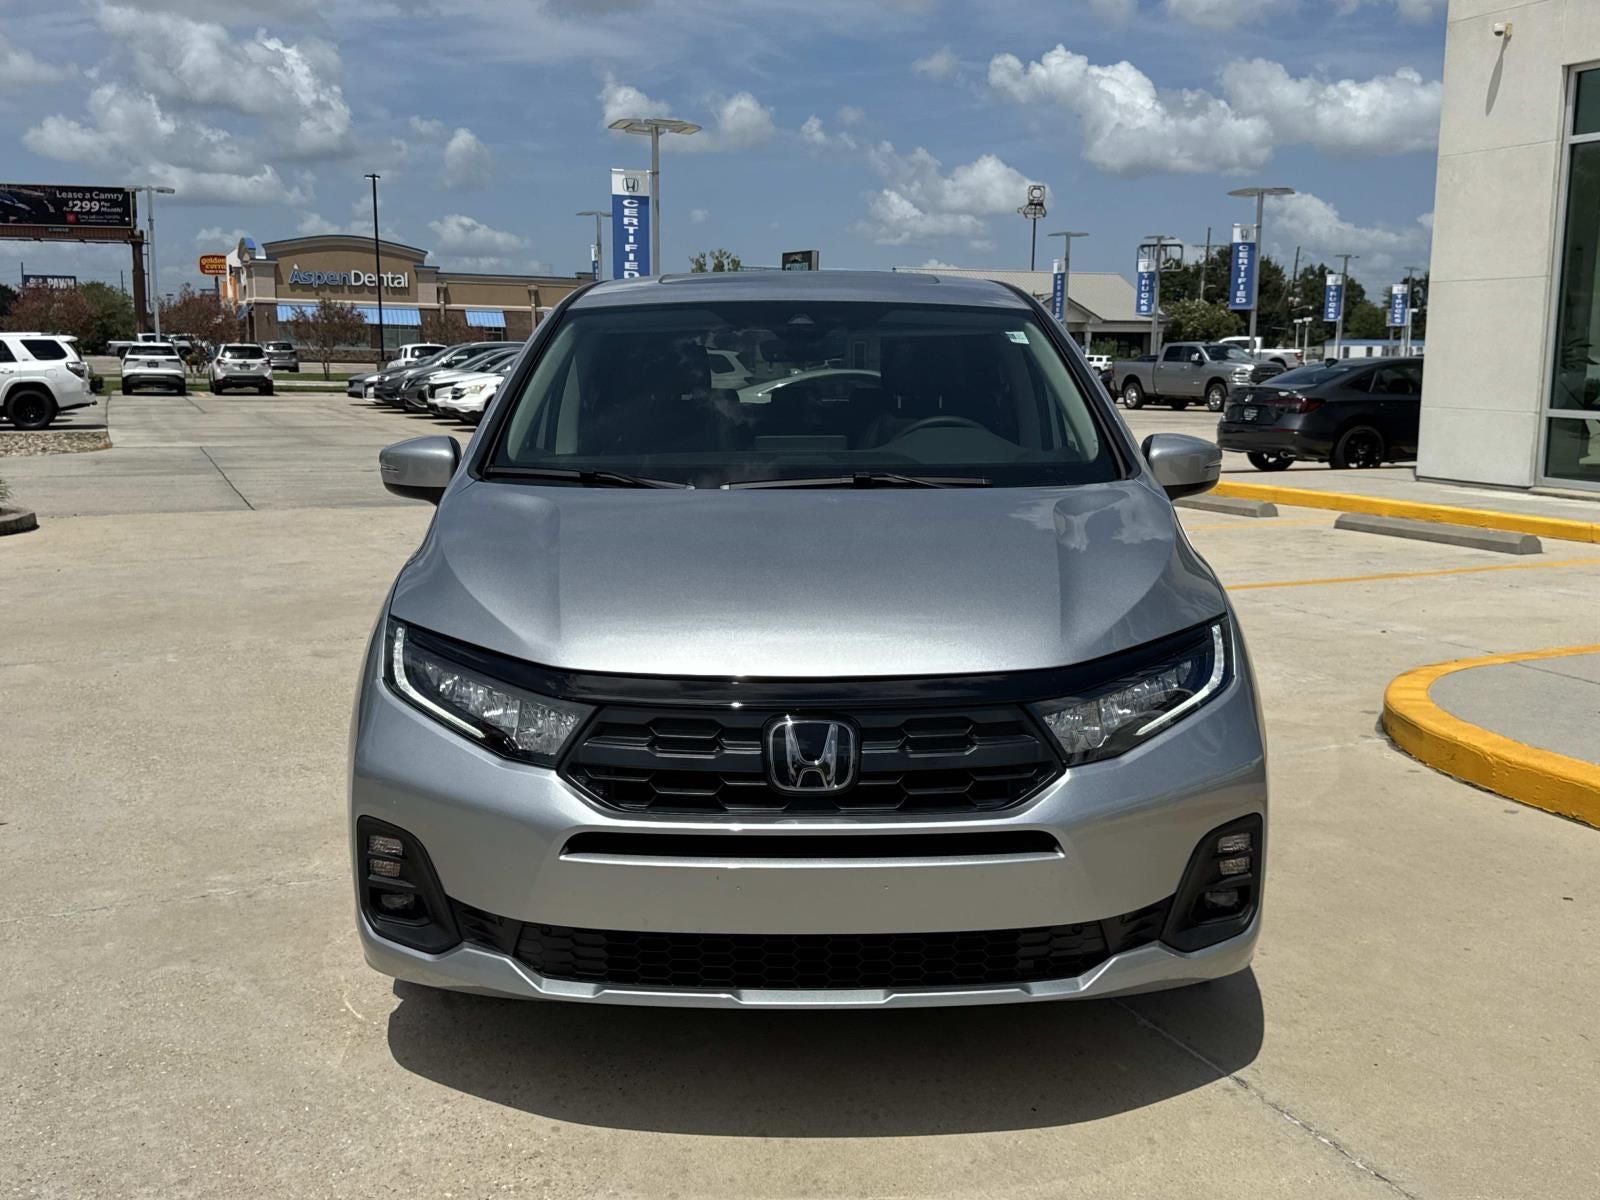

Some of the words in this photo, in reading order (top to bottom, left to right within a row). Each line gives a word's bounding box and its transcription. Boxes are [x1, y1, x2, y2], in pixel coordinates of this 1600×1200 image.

[56, 190, 83, 199] Lease
[92, 191, 124, 202] Camry
[622, 199, 639, 279] CERTIFIED
[1140, 273, 1150, 312] TRUCKS
[1235, 245, 1249, 304] CERTIFIED
